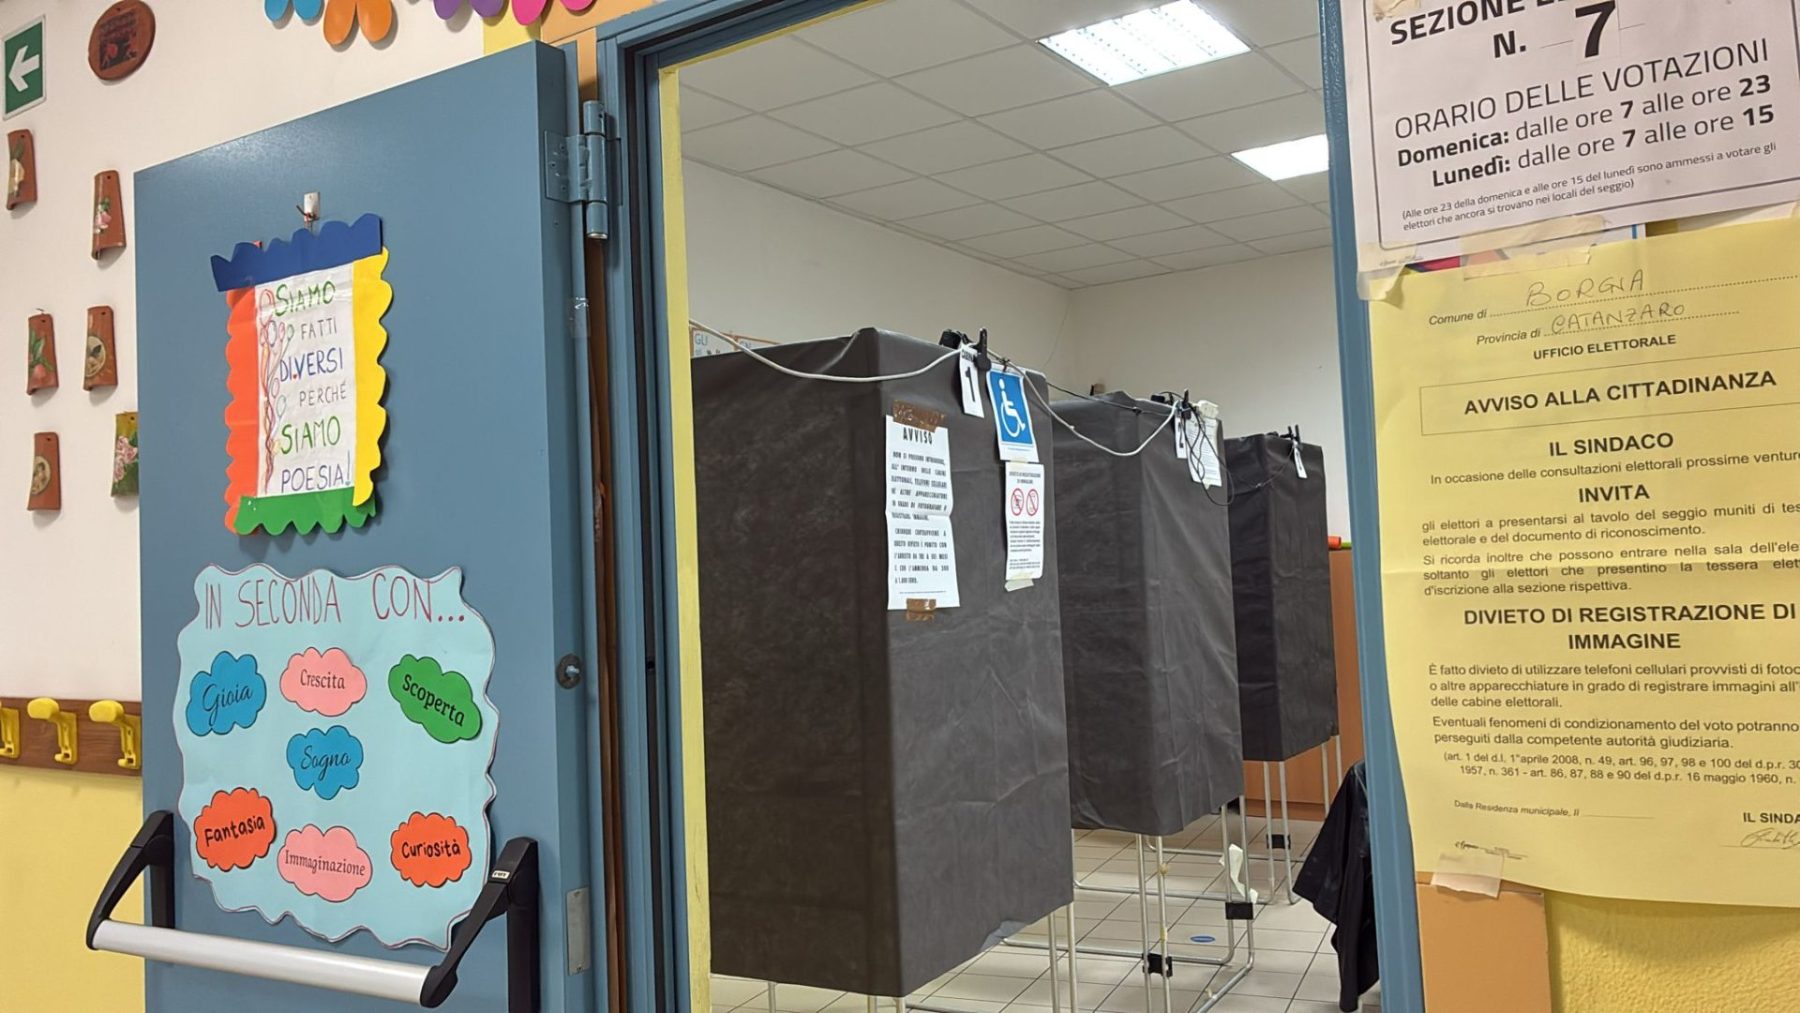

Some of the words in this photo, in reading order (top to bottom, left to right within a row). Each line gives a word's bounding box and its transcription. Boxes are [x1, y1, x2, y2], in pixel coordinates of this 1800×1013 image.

[1390, 0, 1525, 45] SEZIONE
[1494, 30, 1526, 58] N.
[1575, 0, 1616, 58] 7
[1395, 97, 1496, 138] ORARIO
[1505, 74, 1594, 113] DELLE
[1602, 38, 1767, 91] VOTAZIONI
[1397, 131, 1509, 166] Domenica:
[1515, 115, 1568, 140] dalle
[1575, 109, 1612, 127] ore
[1620, 100, 1633, 118] 7
[1642, 92, 1684, 114] alle
[1691, 86, 1731, 105] ore
[1738, 74, 1770, 96] 23
[1432, 155, 1510, 186] Lunedì:
[1517, 143, 1570, 168] dalle
[1577, 137, 1614, 156] ore
[1622, 129, 1636, 147] 7
[1644, 121, 1686, 143] alle
[1694, 116, 1733, 135] ore
[1742, 104, 1774, 125] 15
[1402, 209, 1421, 220] (Alle
[1423, 206, 1438, 215] ore
[1439, 202, 1452, 211] 23
[1453, 198, 1475, 208] della
[1477, 189, 1522, 204] domenica
[1532, 183, 1549, 193] alle
[1550, 180, 1570, 189] ore
[1571, 176, 1584, 185] 15
[1586, 173, 1601, 182] del
[1603, 167, 1635, 179] lunedì
[1636, 162, 1663, 173] sono
[1665, 153, 1714, 168] ammessi
[1725, 146, 1761, 158] votare
[1762, 142, 1776, 154] gli
[1403, 218, 1435, 230] elettori
[1436, 215, 1453, 224] che
[1454, 209, 1485, 221] ancora
[1496, 199, 1533, 212] trovano
[1535, 195, 1550, 204] nei
[1551, 189, 1577, 201] locali
[1579, 185, 1595, 196] del
[1597, 178, 1634, 193] seggio)
[275, 280, 336, 316] SIAMO
[300, 318, 338, 340] FATTI
[1429, 312, 1473, 325] Comune
[1476, 308, 1488, 320] di
[1476, 330, 1529, 345] Provincia
[1530, 328, 1542, 338] di
[1550, 302, 1686, 335] CATANZARO
[1533, 345, 1584, 359] UFFICIO
[1587, 334, 1676, 353] ELETTORALE
[300, 380, 346, 407] PERCHÉ
[965, 366, 976, 402] 1
[1464, 394, 1538, 414] AVVISO
[1544, 387, 1600, 406] ALLA
[1606, 370, 1777, 400] CITTADINANZA
[281, 416, 341, 454] SIAMO
[902, 426, 933, 445] AVVISO
[282, 450, 351, 494] POESIA!
[1430, 475, 1442, 484] In
[1444, 472, 1504, 483] occasione
[1507, 469, 1537, 479] delle
[1539, 462, 1622, 477] consultazioni
[1625, 457, 1682, 471] elettorali
[1685, 454, 1749, 470] prossime
[1578, 484, 1650, 502] INVITA
[1421, 521, 1435, 533] gli
[1440, 519, 1480, 529] elettori
[1498, 514, 1567, 529] presentarsi
[1573, 513, 1584, 523] al
[1590, 511, 1630, 522] tavolo
[1635, 509, 1656, 520] del
[1661, 507, 1707, 521] seggio
[1713, 504, 1755, 516] muniti
[1762, 502, 1775, 513] di
[1422, 534, 1476, 545] elettorale
[1490, 532, 1509, 543] del
[1512, 530, 1582, 542] documento
[1585, 528, 1597, 539] di
[1600, 524, 1705, 538] riconoscimento.
[1423, 555, 1435, 565] Si
[1440, 553, 1480, 564] ricorda
[1486, 552, 1524, 562] inoltre
[1529, 551, 1552, 561] che
[1558, 550, 1614, 562] possono
[1619, 548, 1668, 558] entrare
[1673, 545, 1707, 556] nella
[1713, 544, 1743, 554] sala
[1422, 570, 1471, 580] soltanto
[1479, 569, 1495, 580] gli
[1505, 567, 1549, 577] elettori
[1560, 566, 1585, 575] che
[1596, 562, 1667, 577] presentino
[1680, 562, 1693, 572] la
[1706, 561, 1759, 571] tessera
[206, 582, 222, 629] IN
[235, 576, 342, 628] SECONDA
[372, 573, 465, 622] CON...
[1423, 584, 1489, 595] d'iscrizione
[1492, 583, 1514, 593] alla
[1517, 582, 1566, 593] sezione
[1569, 581, 1631, 593] rispettiva.
[1464, 608, 1545, 624] DIVIETO
[1551, 608, 1572, 622] DI
[1579, 604, 1765, 622] REGISTRAZIONE
[1772, 603, 1796, 619] DI
[1568, 633, 1681, 649] IMMAGINE
[300, 669, 346, 690] Crescita
[1439, 664, 1466, 674] fatto
[1468, 664, 1509, 674] divieto
[1510, 664, 1522, 674] di
[1524, 664, 1581, 674] utilizzare
[1584, 664, 1632, 674] telefoni
[1634, 664, 1687, 674] cellulari
[1689, 663, 1747, 677] provvisti
[1750, 663, 1763, 674] di
[402, 674, 465, 727] Scoperta
[1430, 696, 1458, 706] delle
[1461, 696, 1502, 706] cabine
[1505, 696, 1562, 707] elettorali.
[1440, 680, 1466, 690] altre
[1468, 680, 1569, 693] apparecchiature
[1572, 680, 1584, 690] in
[1587, 680, 1625, 693] grado
[1628, 681, 1640, 691] di
[1644, 681, 1709, 694] registrare
[1712, 681, 1775, 694] immagini
[202, 683, 253, 726] Gioia
[1432, 716, 1486, 727] Eventuali
[1488, 717, 1546, 728] fenomeni
[1549, 718, 1561, 728] di
[1563, 718, 1676, 730] condizionamento
[1679, 719, 1700, 730] del
[1702, 720, 1733, 730] voto
[1736, 721, 1799, 733] potranno
[1433, 733, 1490, 745] perseguiti
[1493, 733, 1523, 744] dalla
[1526, 735, 1602, 746] competente
[1605, 735, 1656, 746] autorità
[1659, 736, 1733, 749] giudiziaria.
[300, 745, 351, 782] Sogno
[204, 814, 266, 846] Fantasia
[285, 849, 366, 877] Immaginazione
[402, 838, 462, 860] Curiosità
